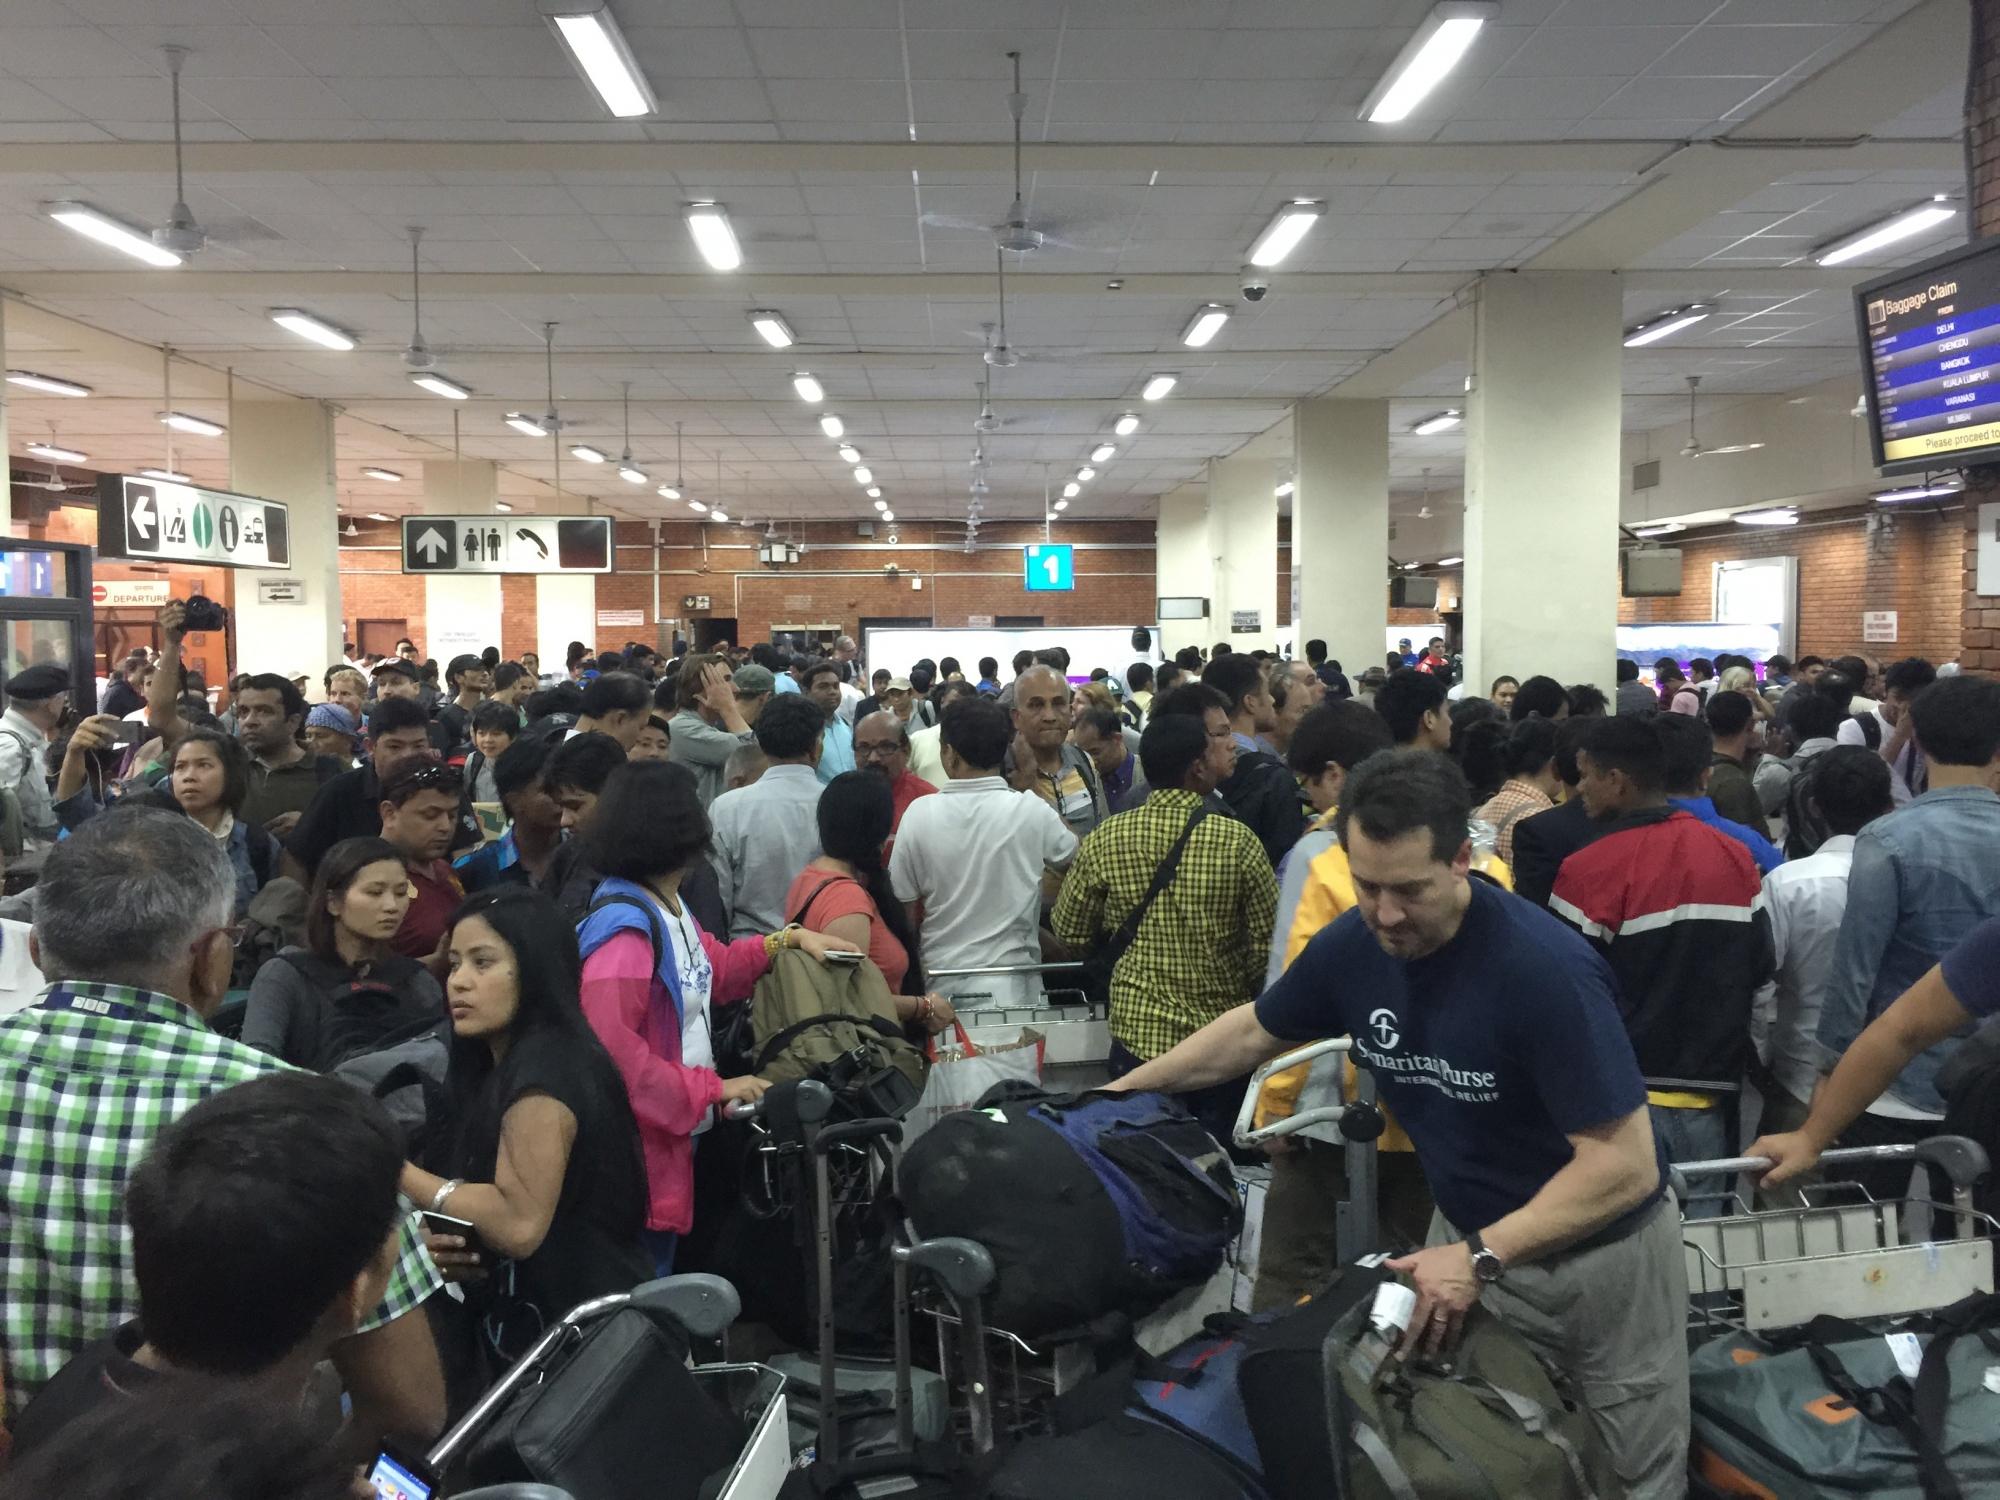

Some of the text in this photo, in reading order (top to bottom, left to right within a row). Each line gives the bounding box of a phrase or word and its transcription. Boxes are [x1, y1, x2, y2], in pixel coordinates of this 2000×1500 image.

[1885, 281, 1958, 315] Baggage Claim
[1936, 323, 1955, 335] DELHI
[1938, 338, 1969, 353] CHENGDU
[1940, 356, 1971, 371] BANGKOK
[1943, 370, 1990, 389] KUALA LUMPUR
[1945, 392, 1976, 406] VARANASI
[1925, 435, 1953, 449] Please
[1955, 428, 1990, 448] proceed
[1042, 554, 1059, 584] 1
[113, 594, 169, 603] DEPARTURE
[1456, 1091, 1500, 1102] RELIEF
